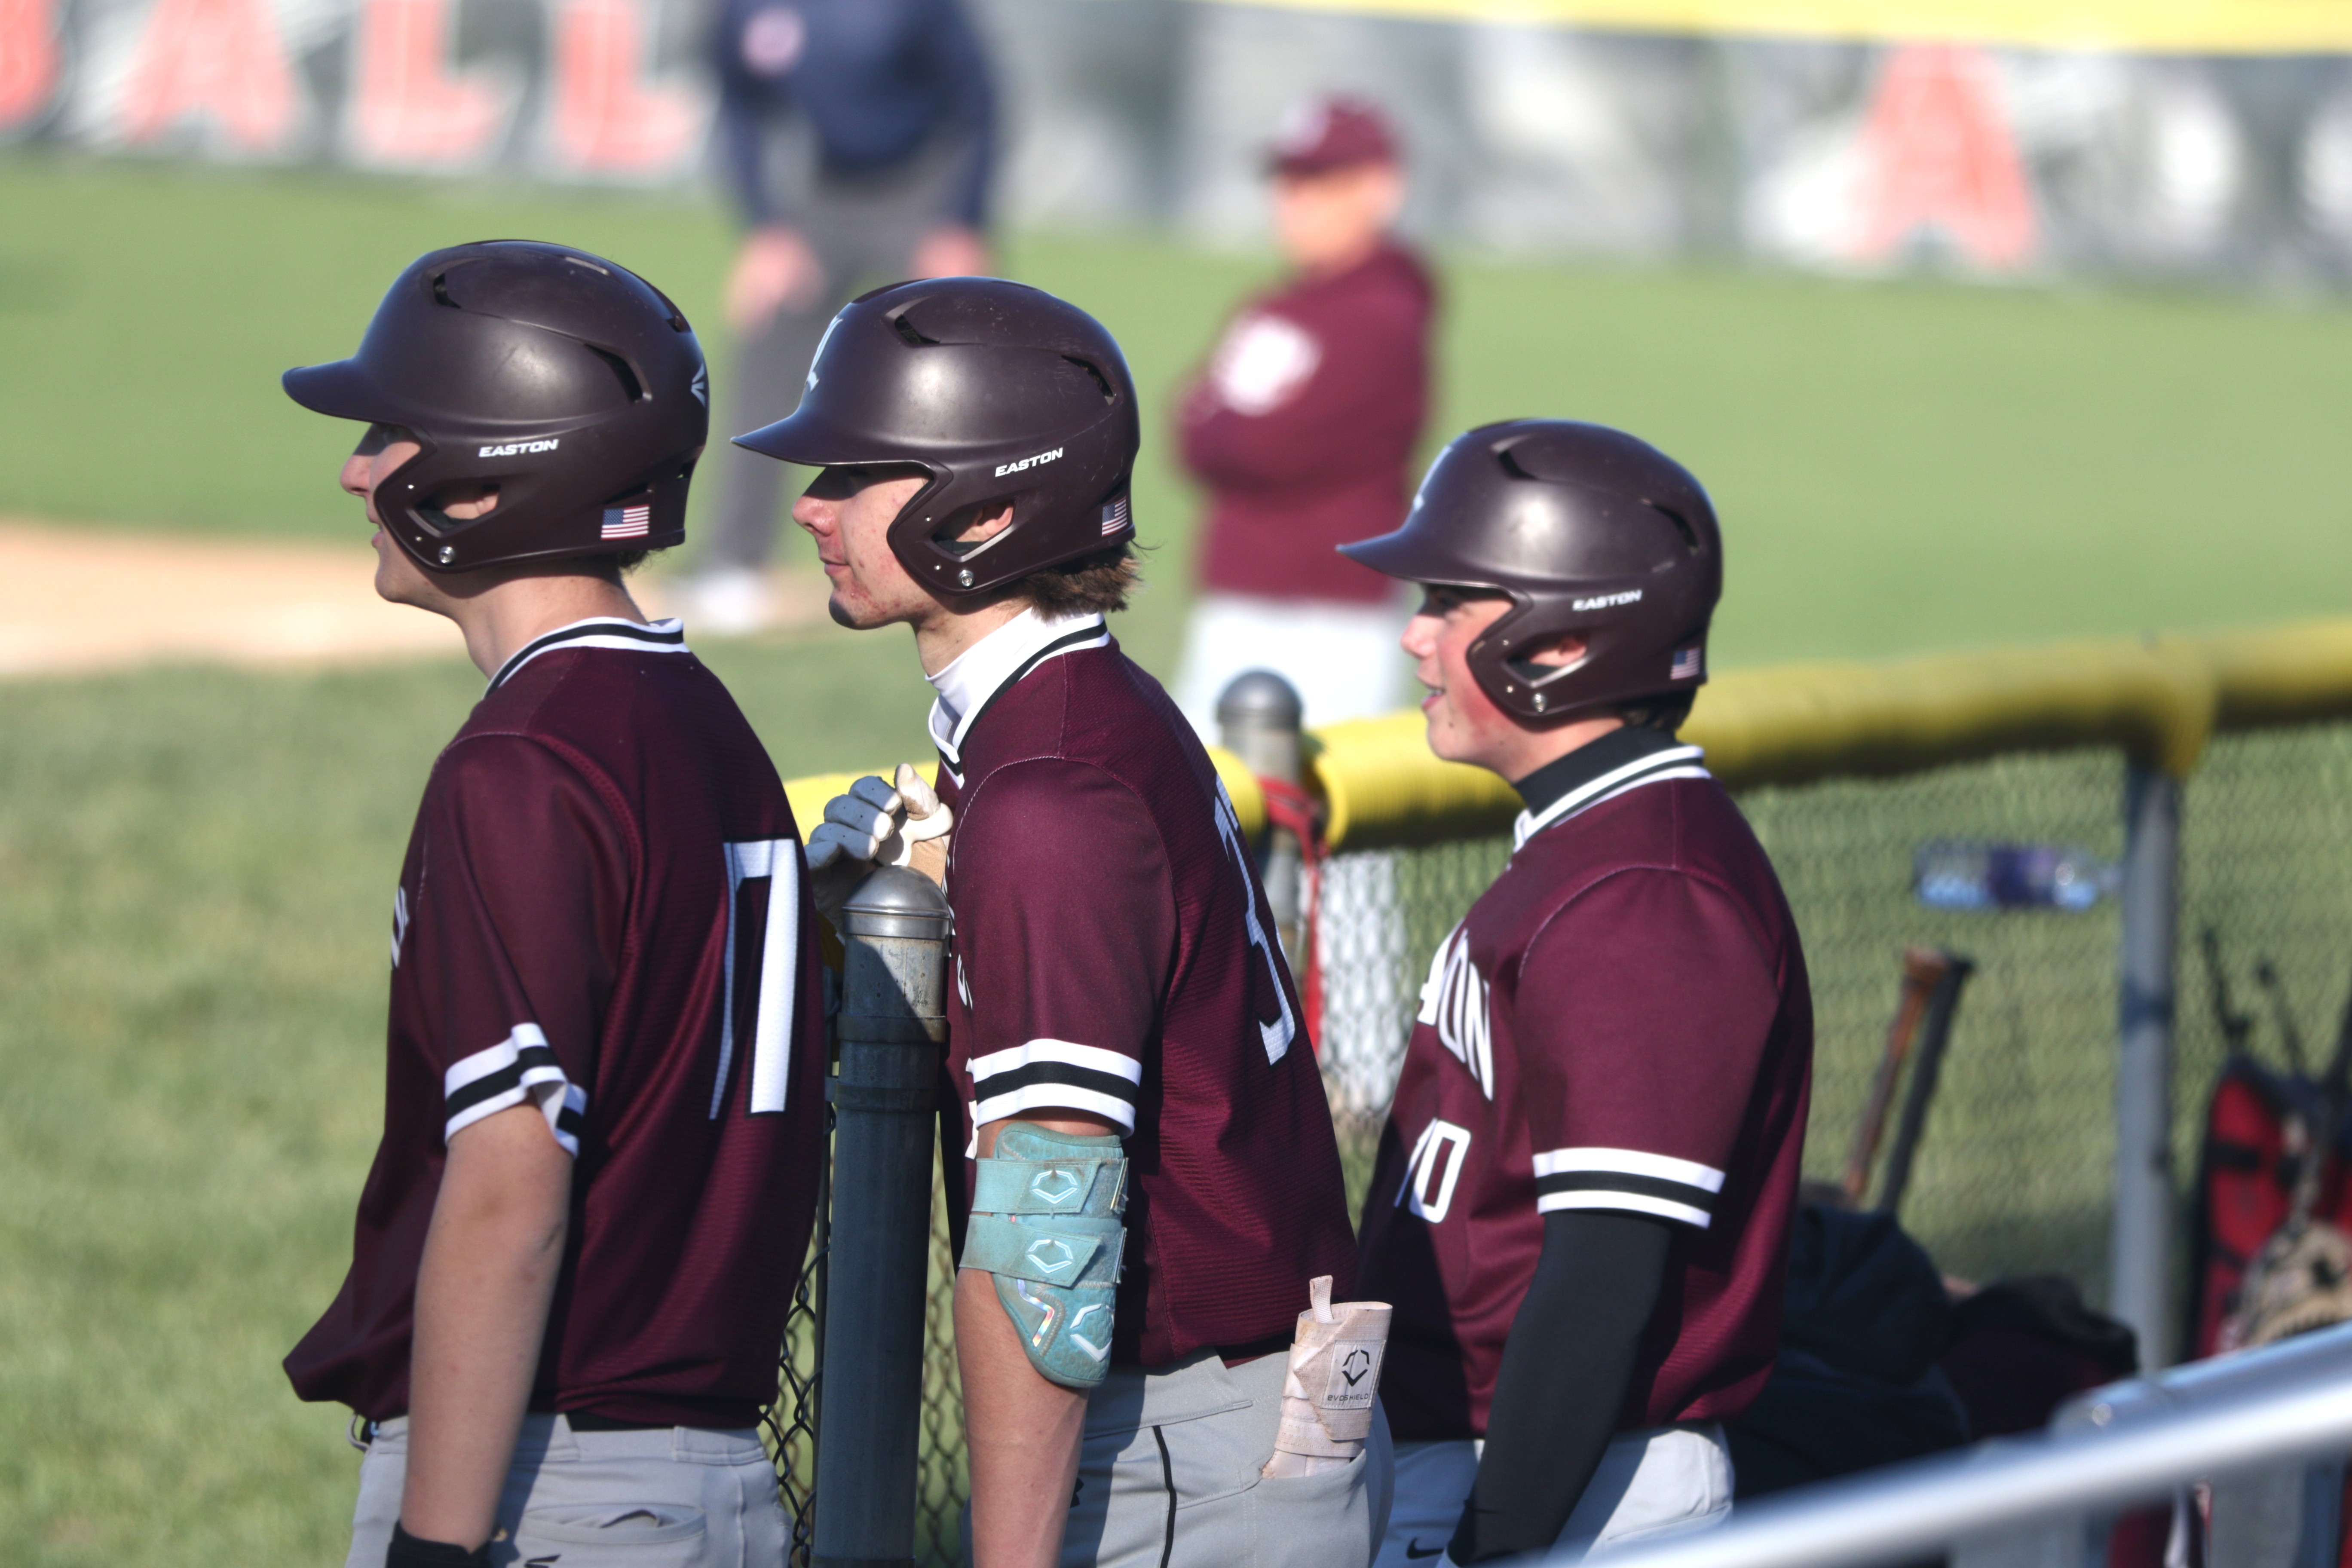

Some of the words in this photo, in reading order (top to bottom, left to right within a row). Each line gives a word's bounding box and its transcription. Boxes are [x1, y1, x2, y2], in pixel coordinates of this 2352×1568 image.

[478, 438, 559, 457] EASTON
[995, 447, 1063, 477] EASTON
[1572, 589, 1643, 611] EASTON
[708, 838, 799, 1120] 7
